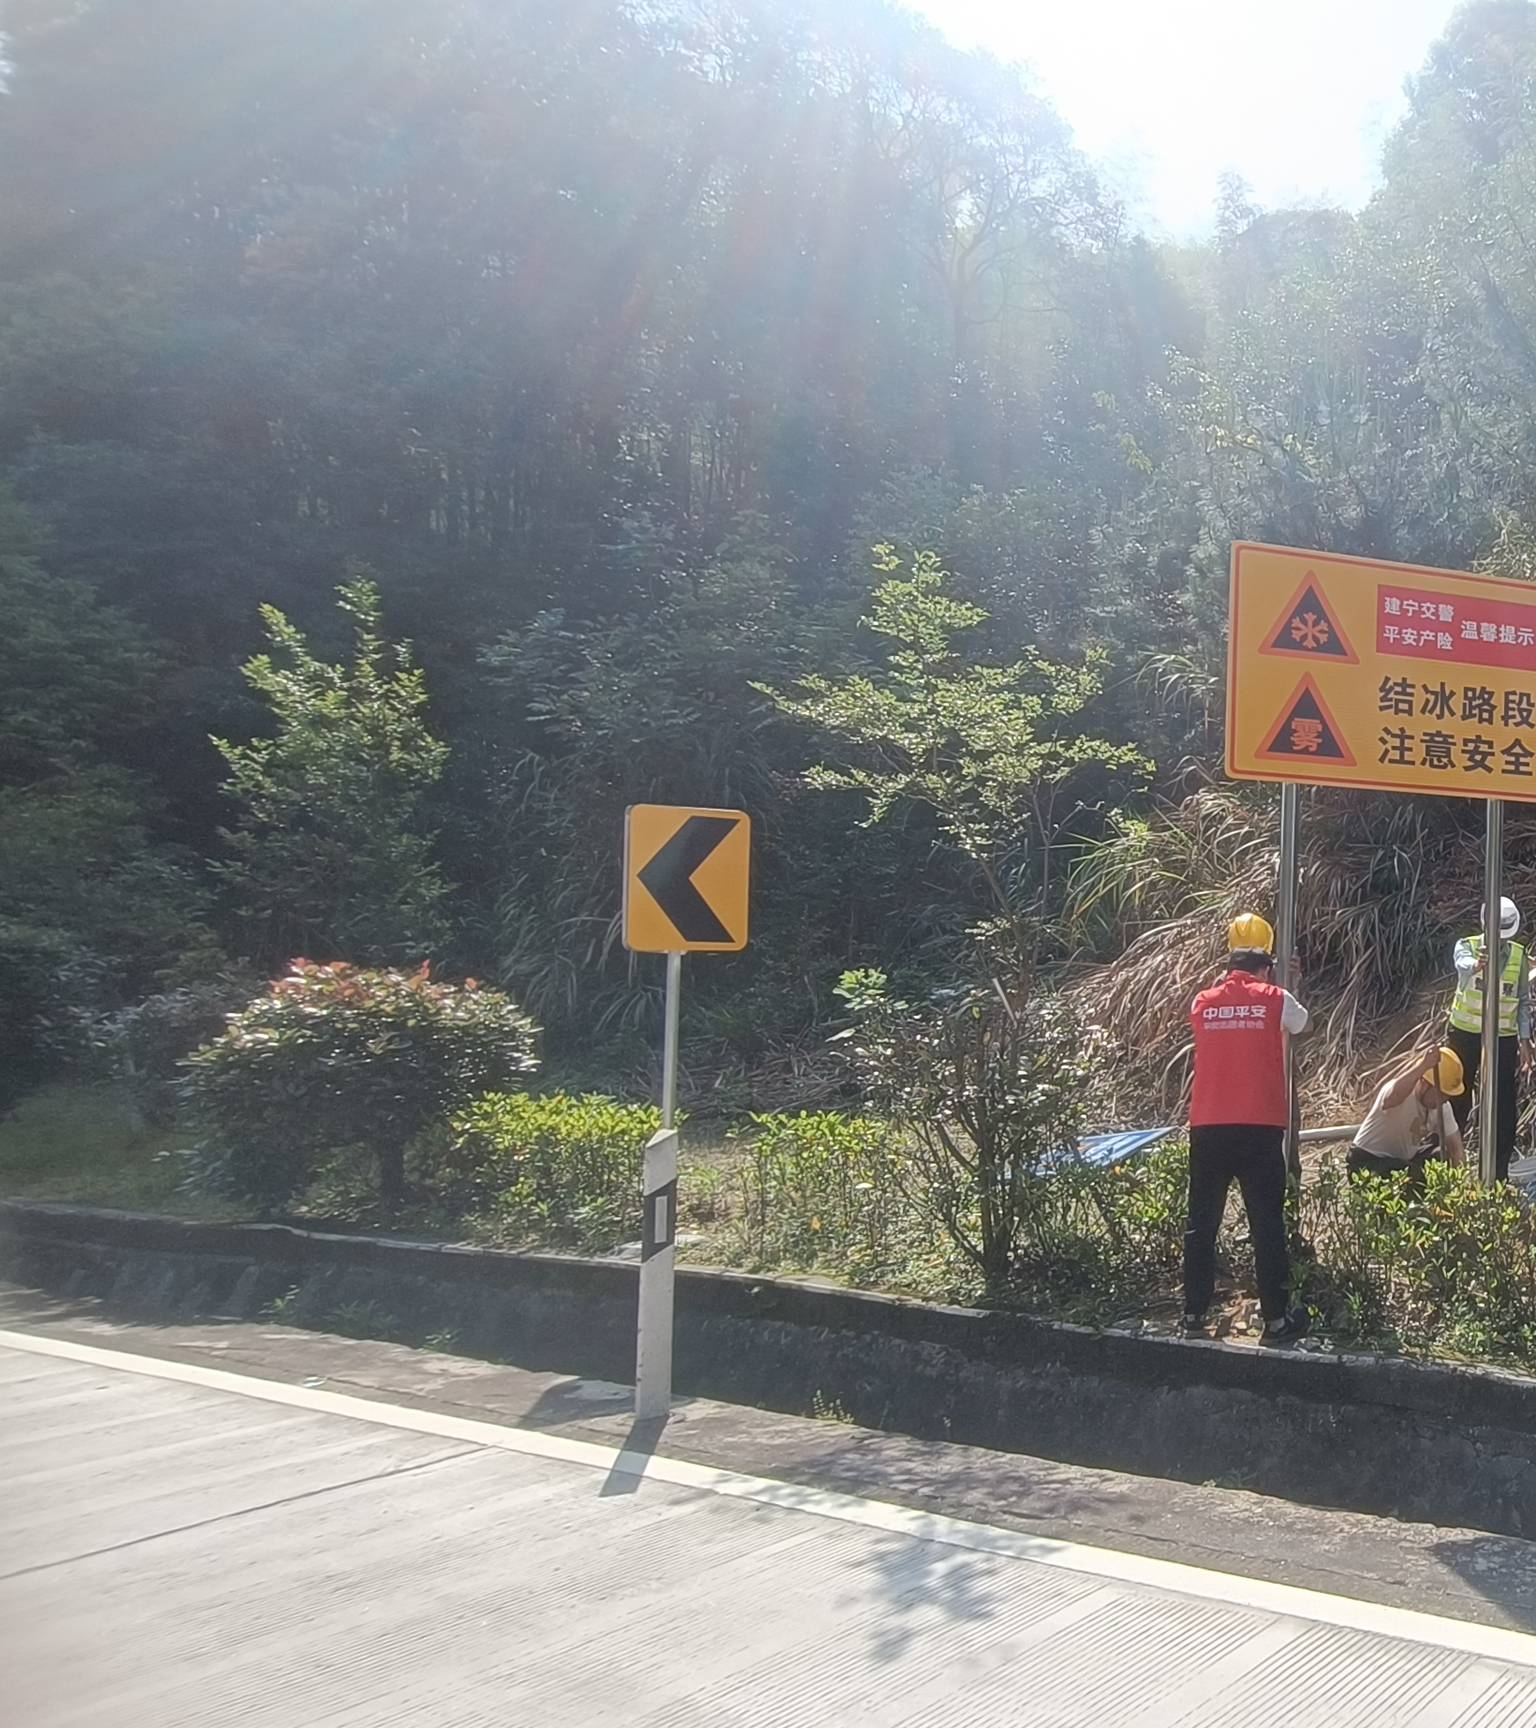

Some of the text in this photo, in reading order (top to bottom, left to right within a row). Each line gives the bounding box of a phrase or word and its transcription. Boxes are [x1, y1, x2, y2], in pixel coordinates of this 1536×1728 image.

[1384, 596, 1455, 623] 建宁交警
[1383, 625, 1454, 651] 平安产险
[1460, 620, 1535, 646] 温馨提示
[1378, 676, 1536, 729] 结冰路段
[1290, 717, 1323, 752] 雾
[1378, 726, 1536, 777] 注意安全
[1203, 1005, 1266, 1019] 中国平安
